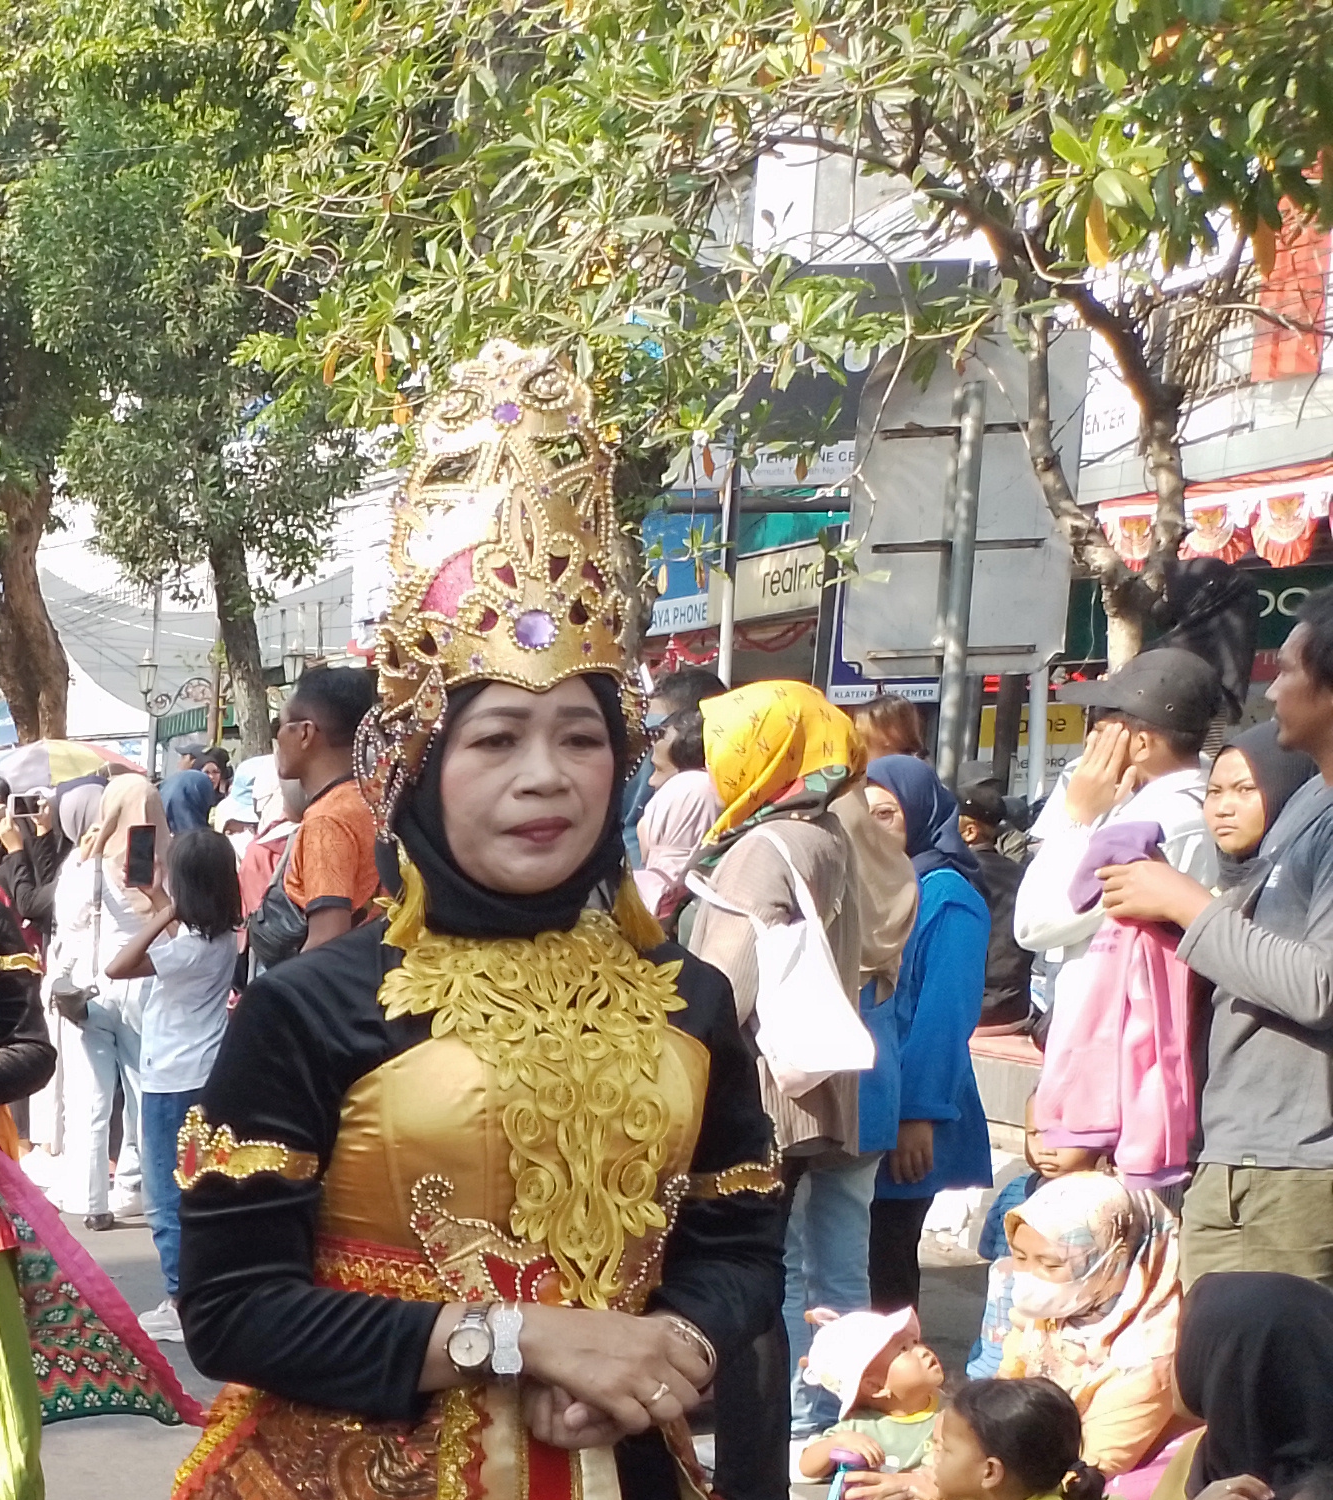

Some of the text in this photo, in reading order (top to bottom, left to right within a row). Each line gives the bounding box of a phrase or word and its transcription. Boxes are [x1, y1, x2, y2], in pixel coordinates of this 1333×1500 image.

[762, 558, 824, 599] realme
[672, 602, 708, 625] PHONE
[834, 690, 867, 698] KLATEN
